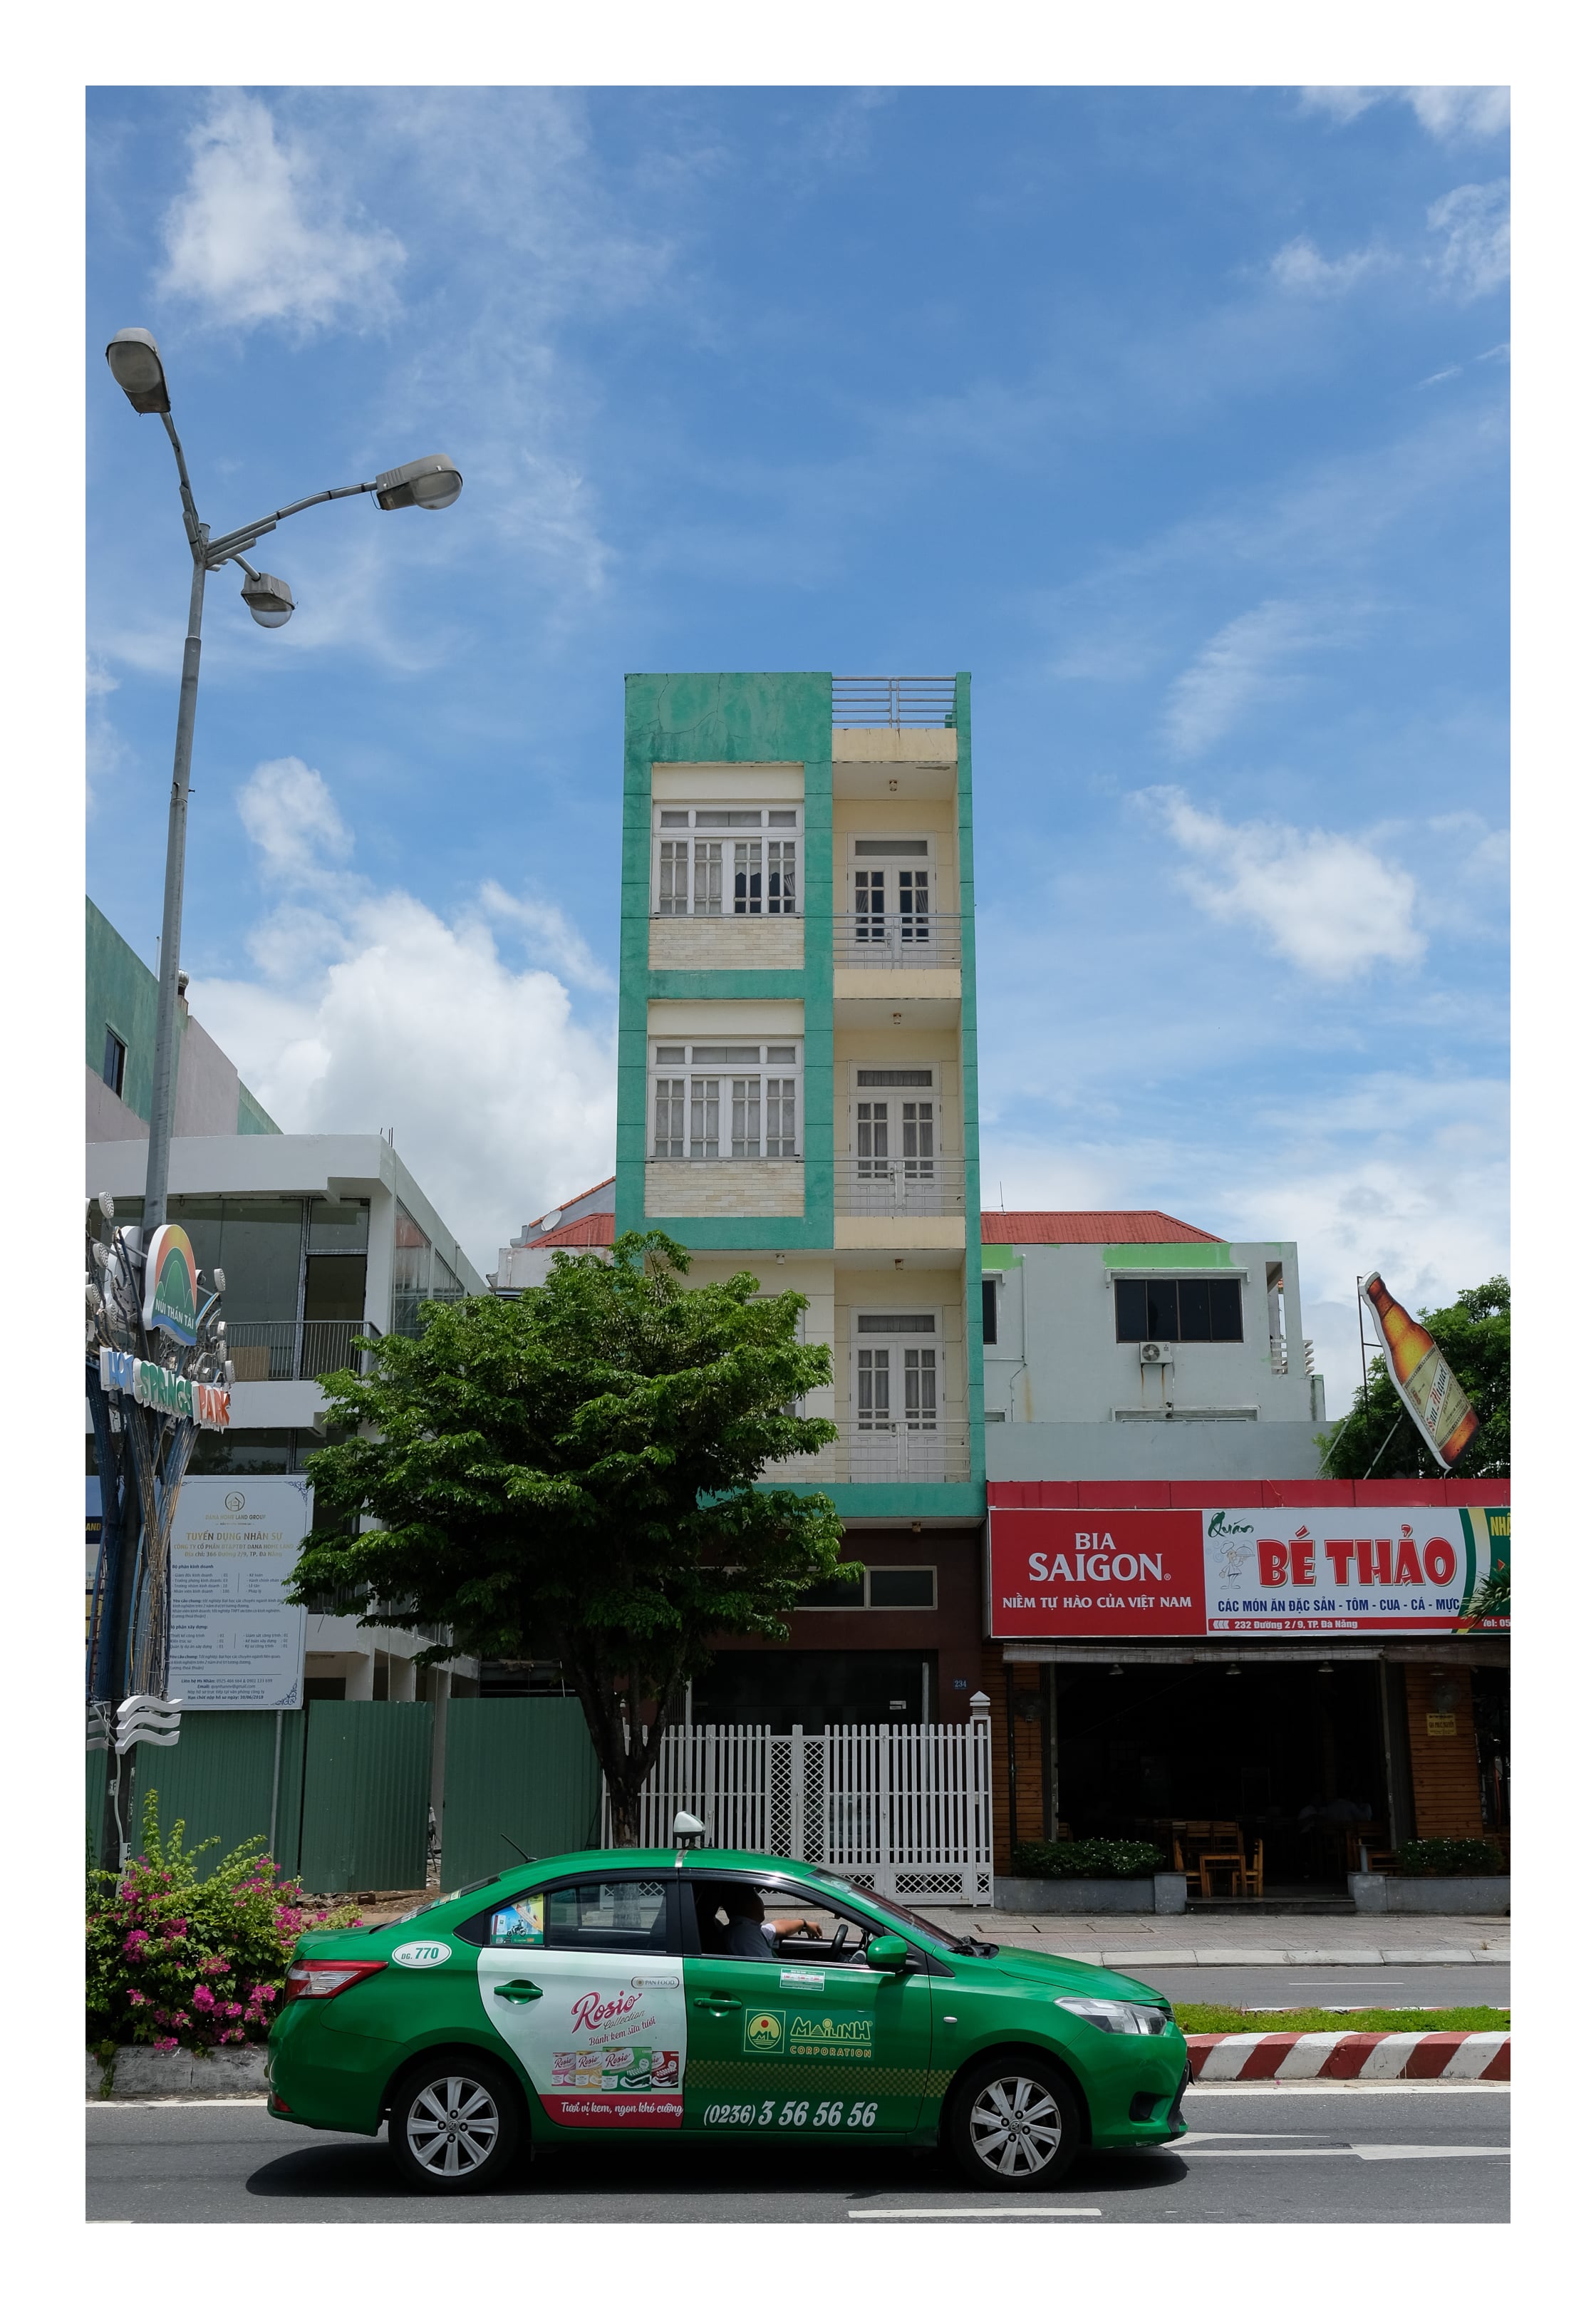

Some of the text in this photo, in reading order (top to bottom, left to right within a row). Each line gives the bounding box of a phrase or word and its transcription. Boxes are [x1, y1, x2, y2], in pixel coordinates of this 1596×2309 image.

[155, 1298, 166, 1315] NÚI
[108, 1351, 231, 1426] HOT SPRINGS PARK
[1208, 1511, 1254, 1538] Quán
[186, 1530, 214, 1541] TUYỂN
[217, 1532, 241, 1541] DỤNG
[244, 1531, 268, 1541] NHÂN
[1075, 1532, 1116, 1550] BIA
[1256, 1524, 1457, 1589] BÉ THẢO
[1028, 1552, 1164, 1581] SAIGON
[1002, 1592, 1192, 1611] NIỀM TỰ HÀO CỦA VIỆT NAM
[1218, 1598, 1240, 1612] CÁC
[1243, 1598, 1268, 1612] MÓN
[1270, 1598, 1286, 1612] ĂN
[1288, 1598, 1310, 1614] ĐẶC
[1314, 1596, 1336, 1611] SẢN
[1345, 1597, 1369, 1611] TÔM
[1379, 1598, 1401, 1611] CUA
[1411, 1596, 1426, 1611] CÁ
[1436, 1598, 1460, 1613] MỰC
[1234, 1621, 1252, 1630] 232
[1253, 1620, 1282, 1630] Đường
[1321, 1620, 1333, 1628] Đà
[1335, 1618, 1358, 1630] Nẵng
[954, 1680, 967, 1688] 234
[415, 1947, 440, 1960] 770
[571, 1990, 643, 2034] Rosio
[603, 2010, 646, 2030] Collection
[589, 2015, 656, 2046] Bánh kem sữa tươi
[579, 2053, 600, 2068] Rosio
[606, 2052, 631, 2067] Rosio
[789, 2045, 871, 2058] CORPORATION
[554, 2056, 572, 2068] Rosio
[561, 2102, 580, 2113] Tươi
[581, 2102, 591, 2116] vị
[614, 2105, 636, 2117] ngon
[638, 2102, 656, 2114] khó
[703, 2100, 879, 2127] (0236) 3 56 56 56
